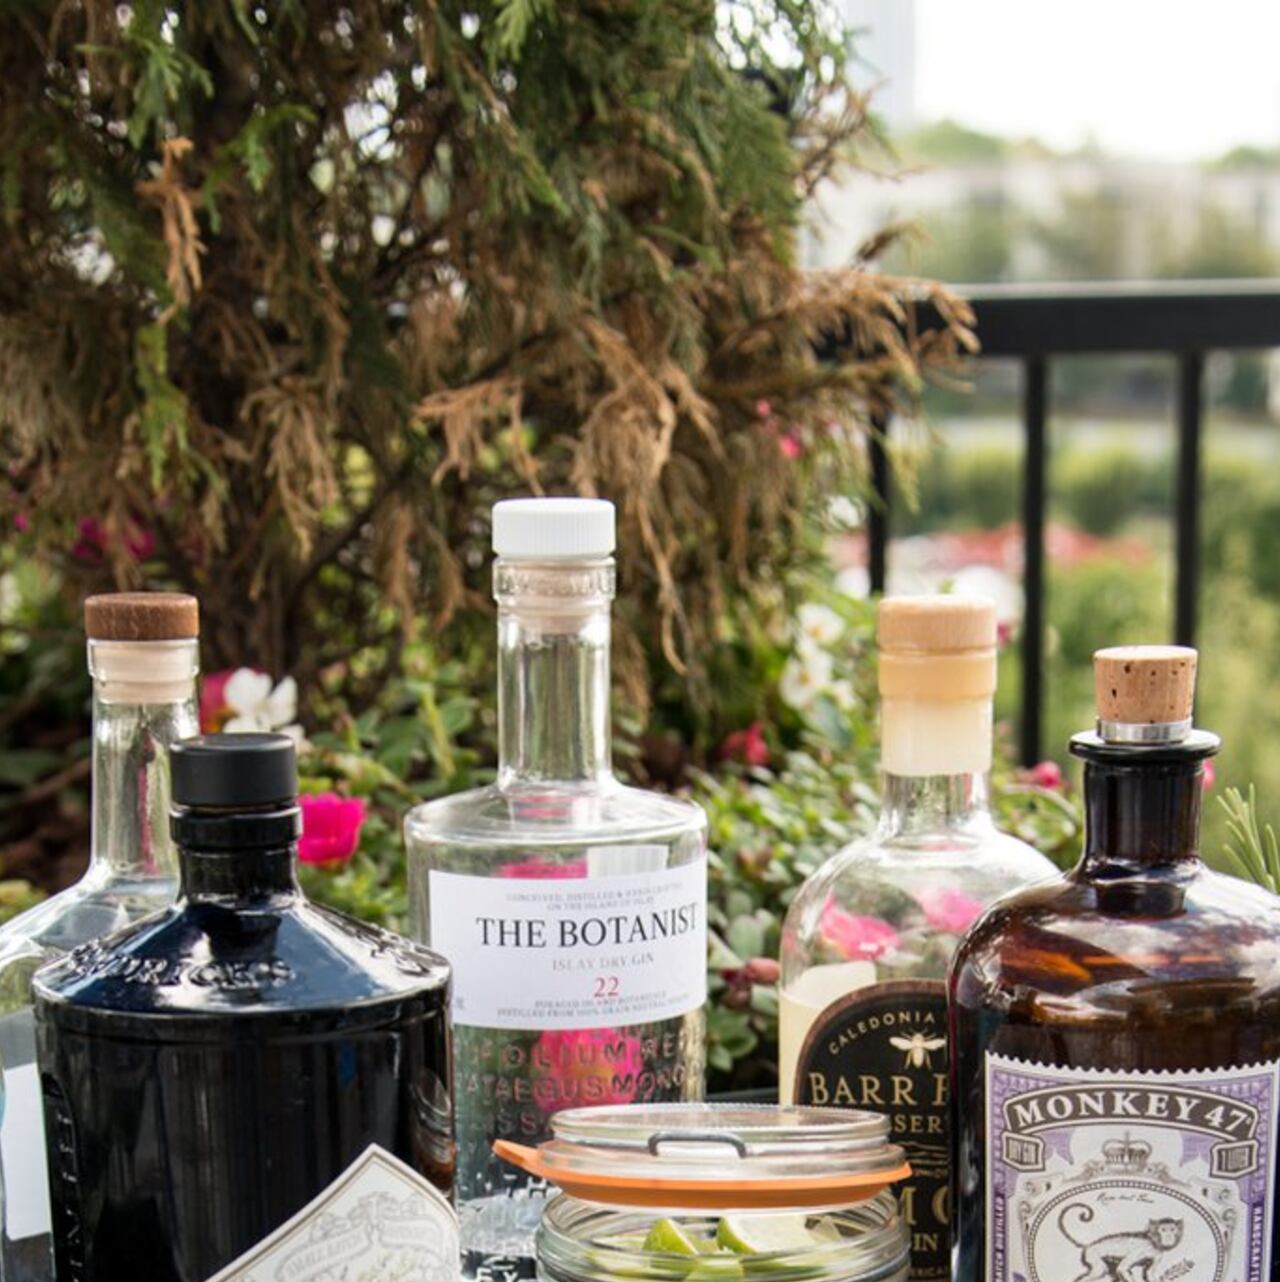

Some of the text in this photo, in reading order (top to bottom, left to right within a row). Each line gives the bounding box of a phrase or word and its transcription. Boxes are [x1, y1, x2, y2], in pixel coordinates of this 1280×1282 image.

[476, 917, 547, 948] THE
[559, 902, 699, 949] BOTANIST
[553, 952, 655, 971] ISLAY DRY GIN
[594, 976, 619, 998] 22
[829, 1011, 936, 1055] CALEDONIA
[1014, 1091, 1248, 1132] MONKEY 47
